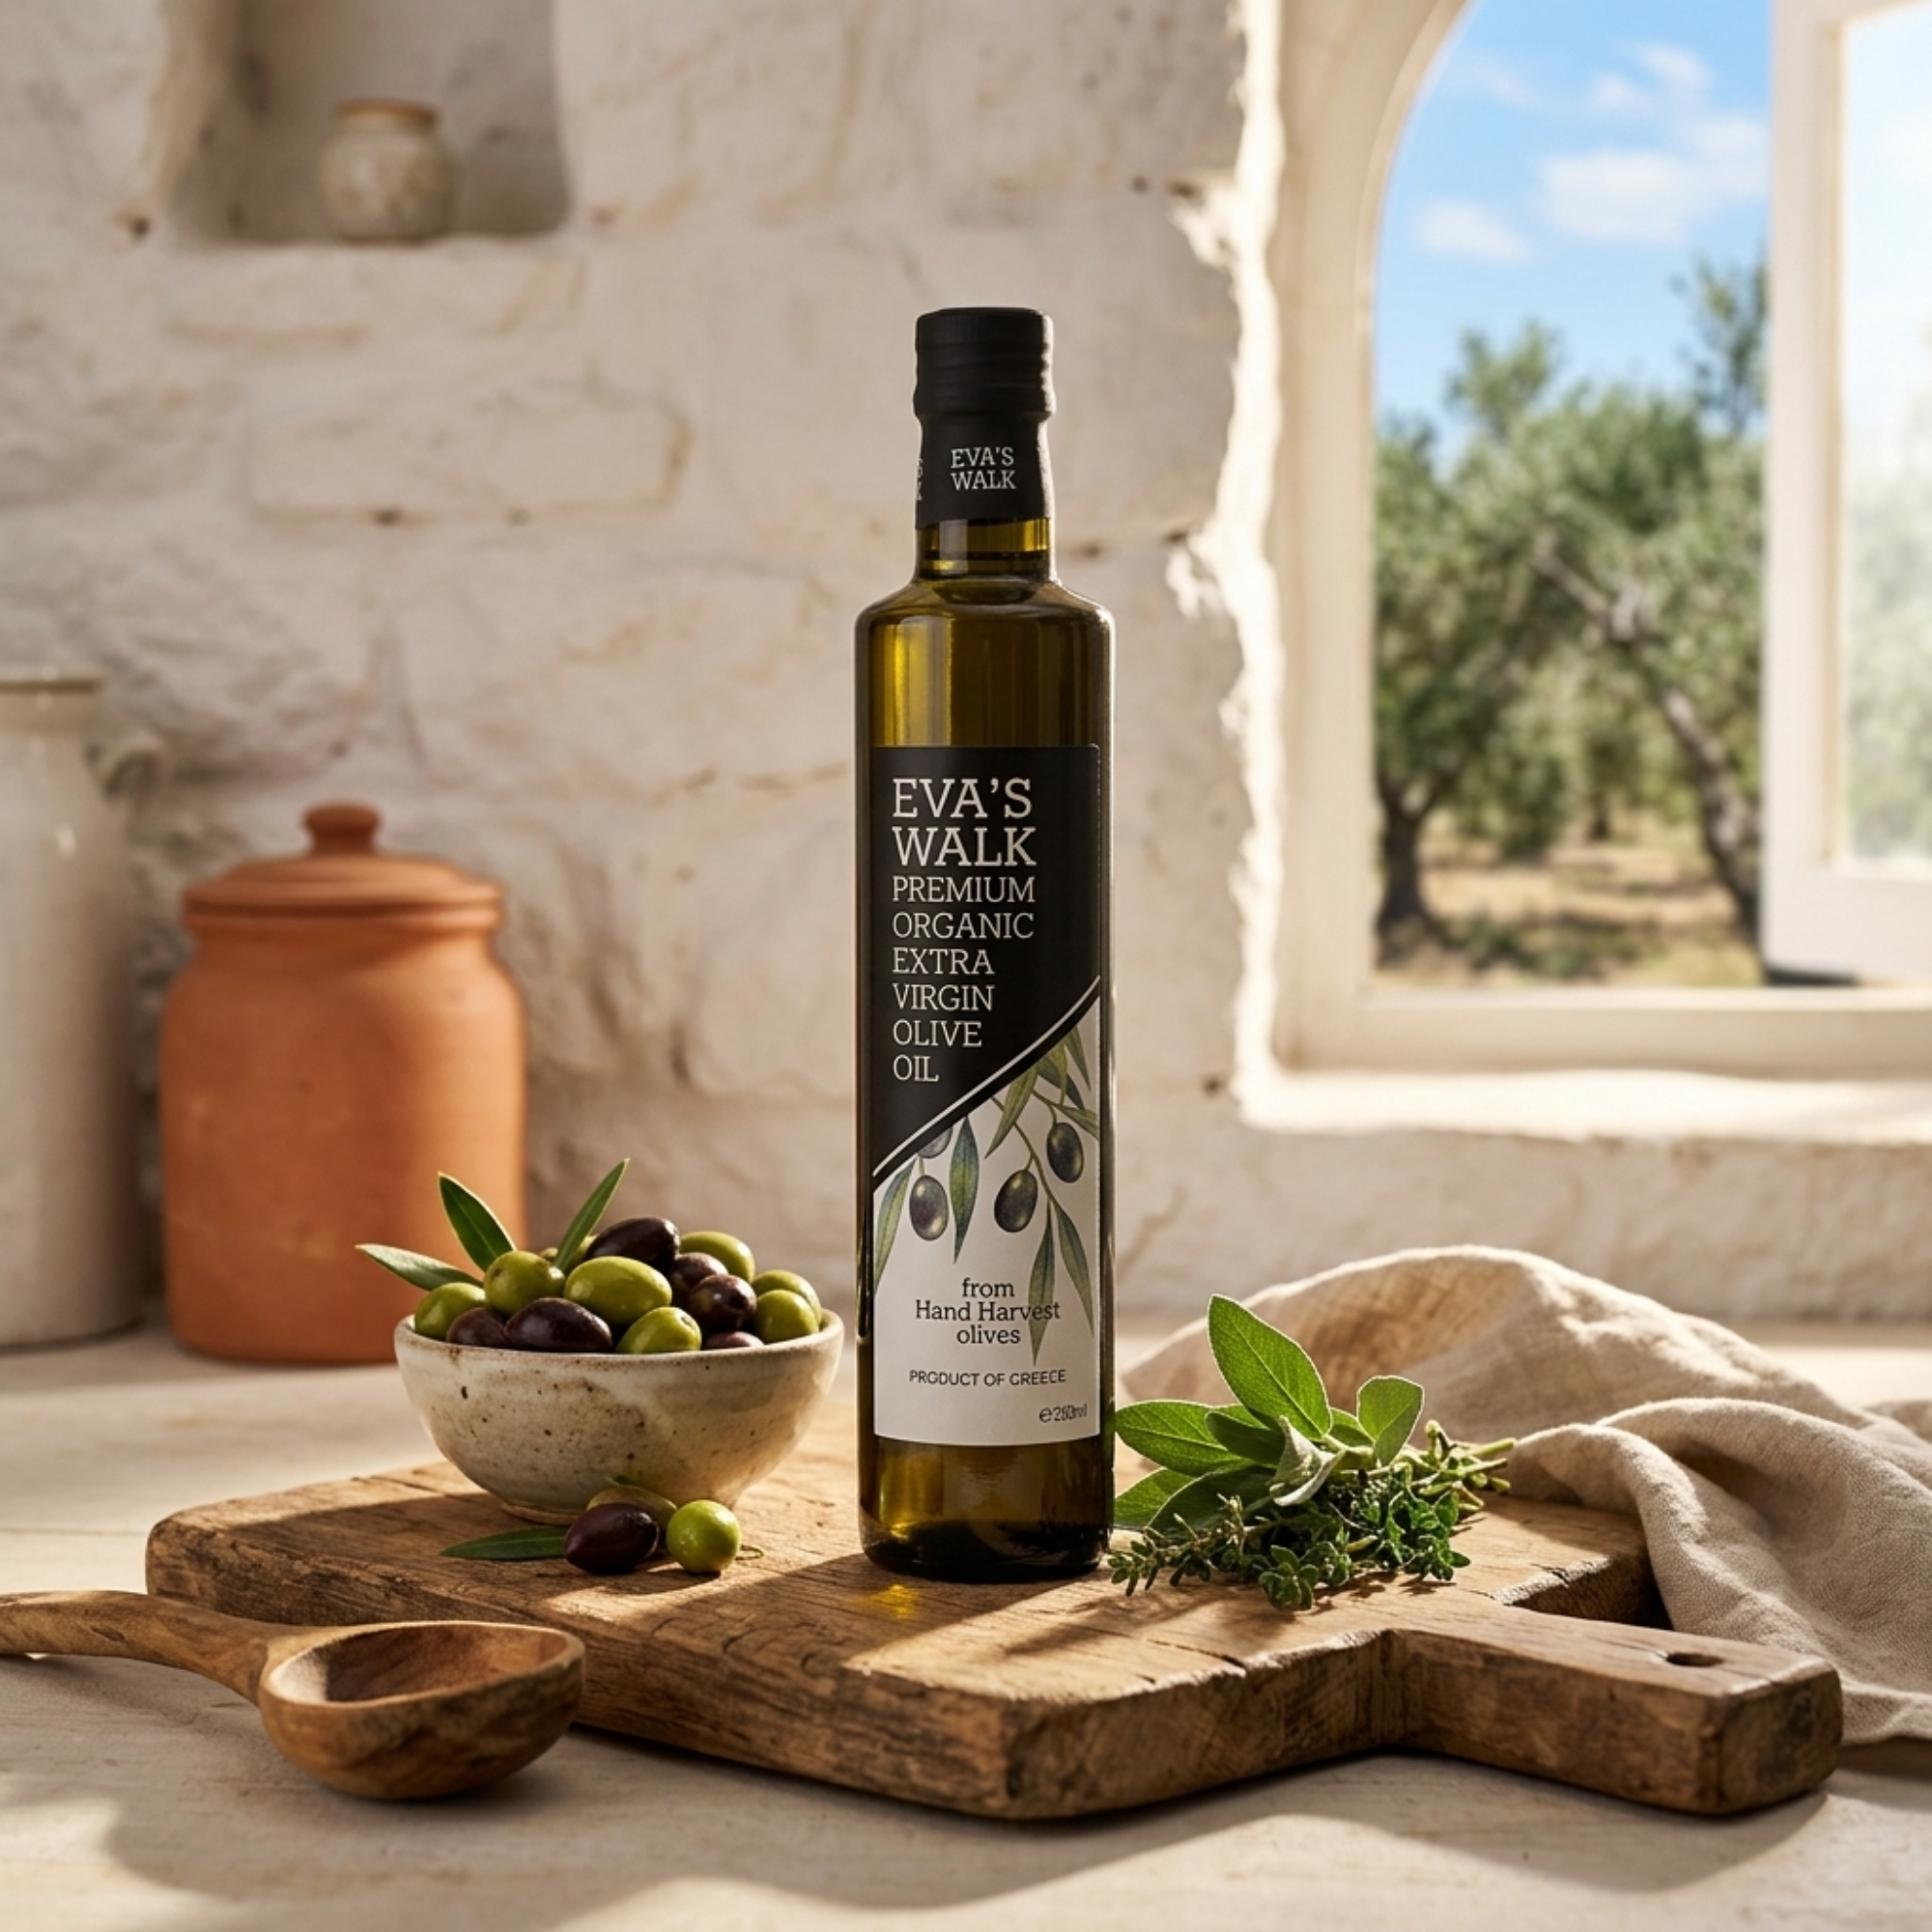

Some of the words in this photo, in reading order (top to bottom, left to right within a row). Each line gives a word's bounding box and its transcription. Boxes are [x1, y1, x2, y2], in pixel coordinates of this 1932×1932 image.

[951, 447, 1013, 468] EVA'S
[951, 470, 1015, 490] WALK
[894, 779, 1030, 817] EVA’S
[893, 827, 1036, 866] WALK
[894, 876, 1034, 902] PREMIUM
[894, 912, 1033, 938] ORGANIC
[893, 948, 993, 974] EXTRA
[893, 983, 993, 1010] VIRGIN
[894, 1019, 981, 1046] OLIVE
[894, 1055, 939, 1081] OIL
[962, 1278, 1014, 1297] from
[917, 1300, 971, 1321] Hand
[977, 1300, 1061, 1321] Harvest
[957, 1324, 1021, 1344] olives
[984, 1374, 1005, 1386] OF
[1009, 1370, 1065, 1385] GREECE
